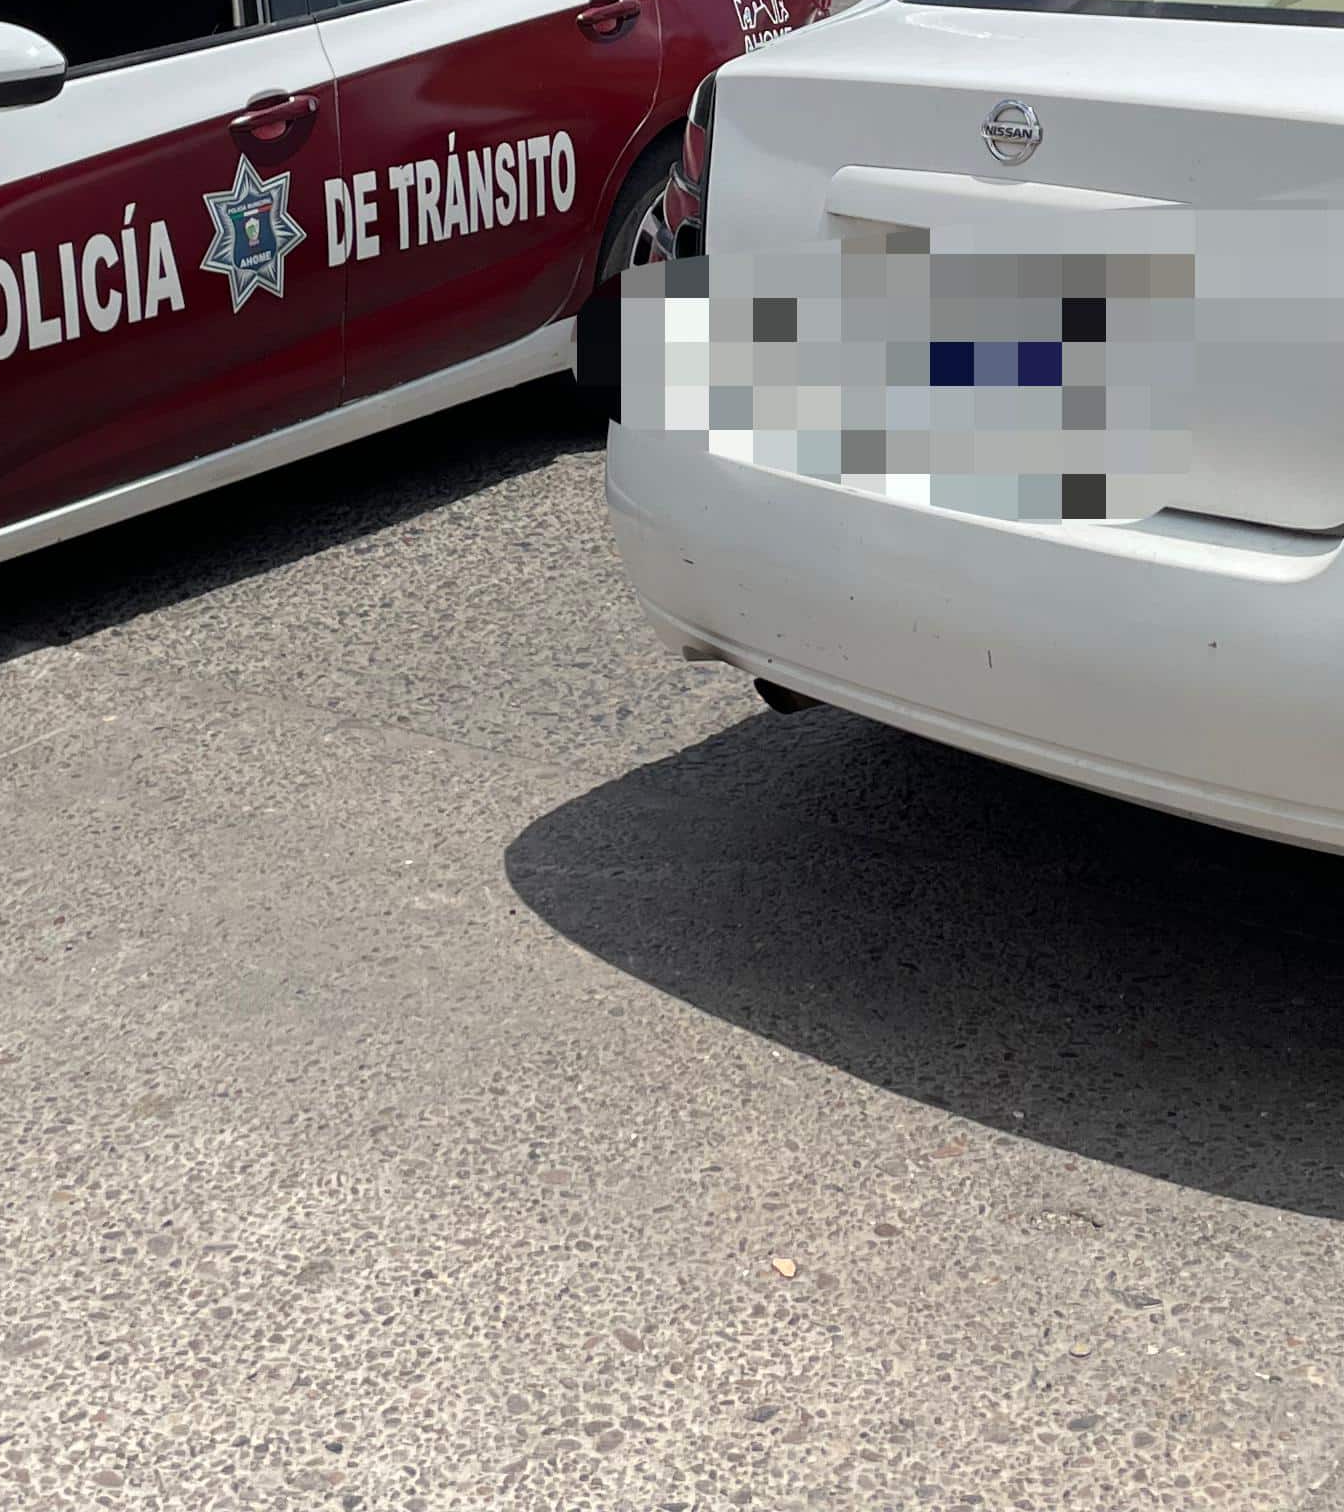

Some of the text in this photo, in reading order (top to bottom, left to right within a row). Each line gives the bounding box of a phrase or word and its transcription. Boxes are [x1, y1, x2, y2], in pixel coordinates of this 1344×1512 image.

[985, 125, 1033, 139] NISSAN
[324, 171, 380, 267] DE
[389, 131, 576, 250] TRÁNSITO
[240, 251, 272, 268] AHOME
